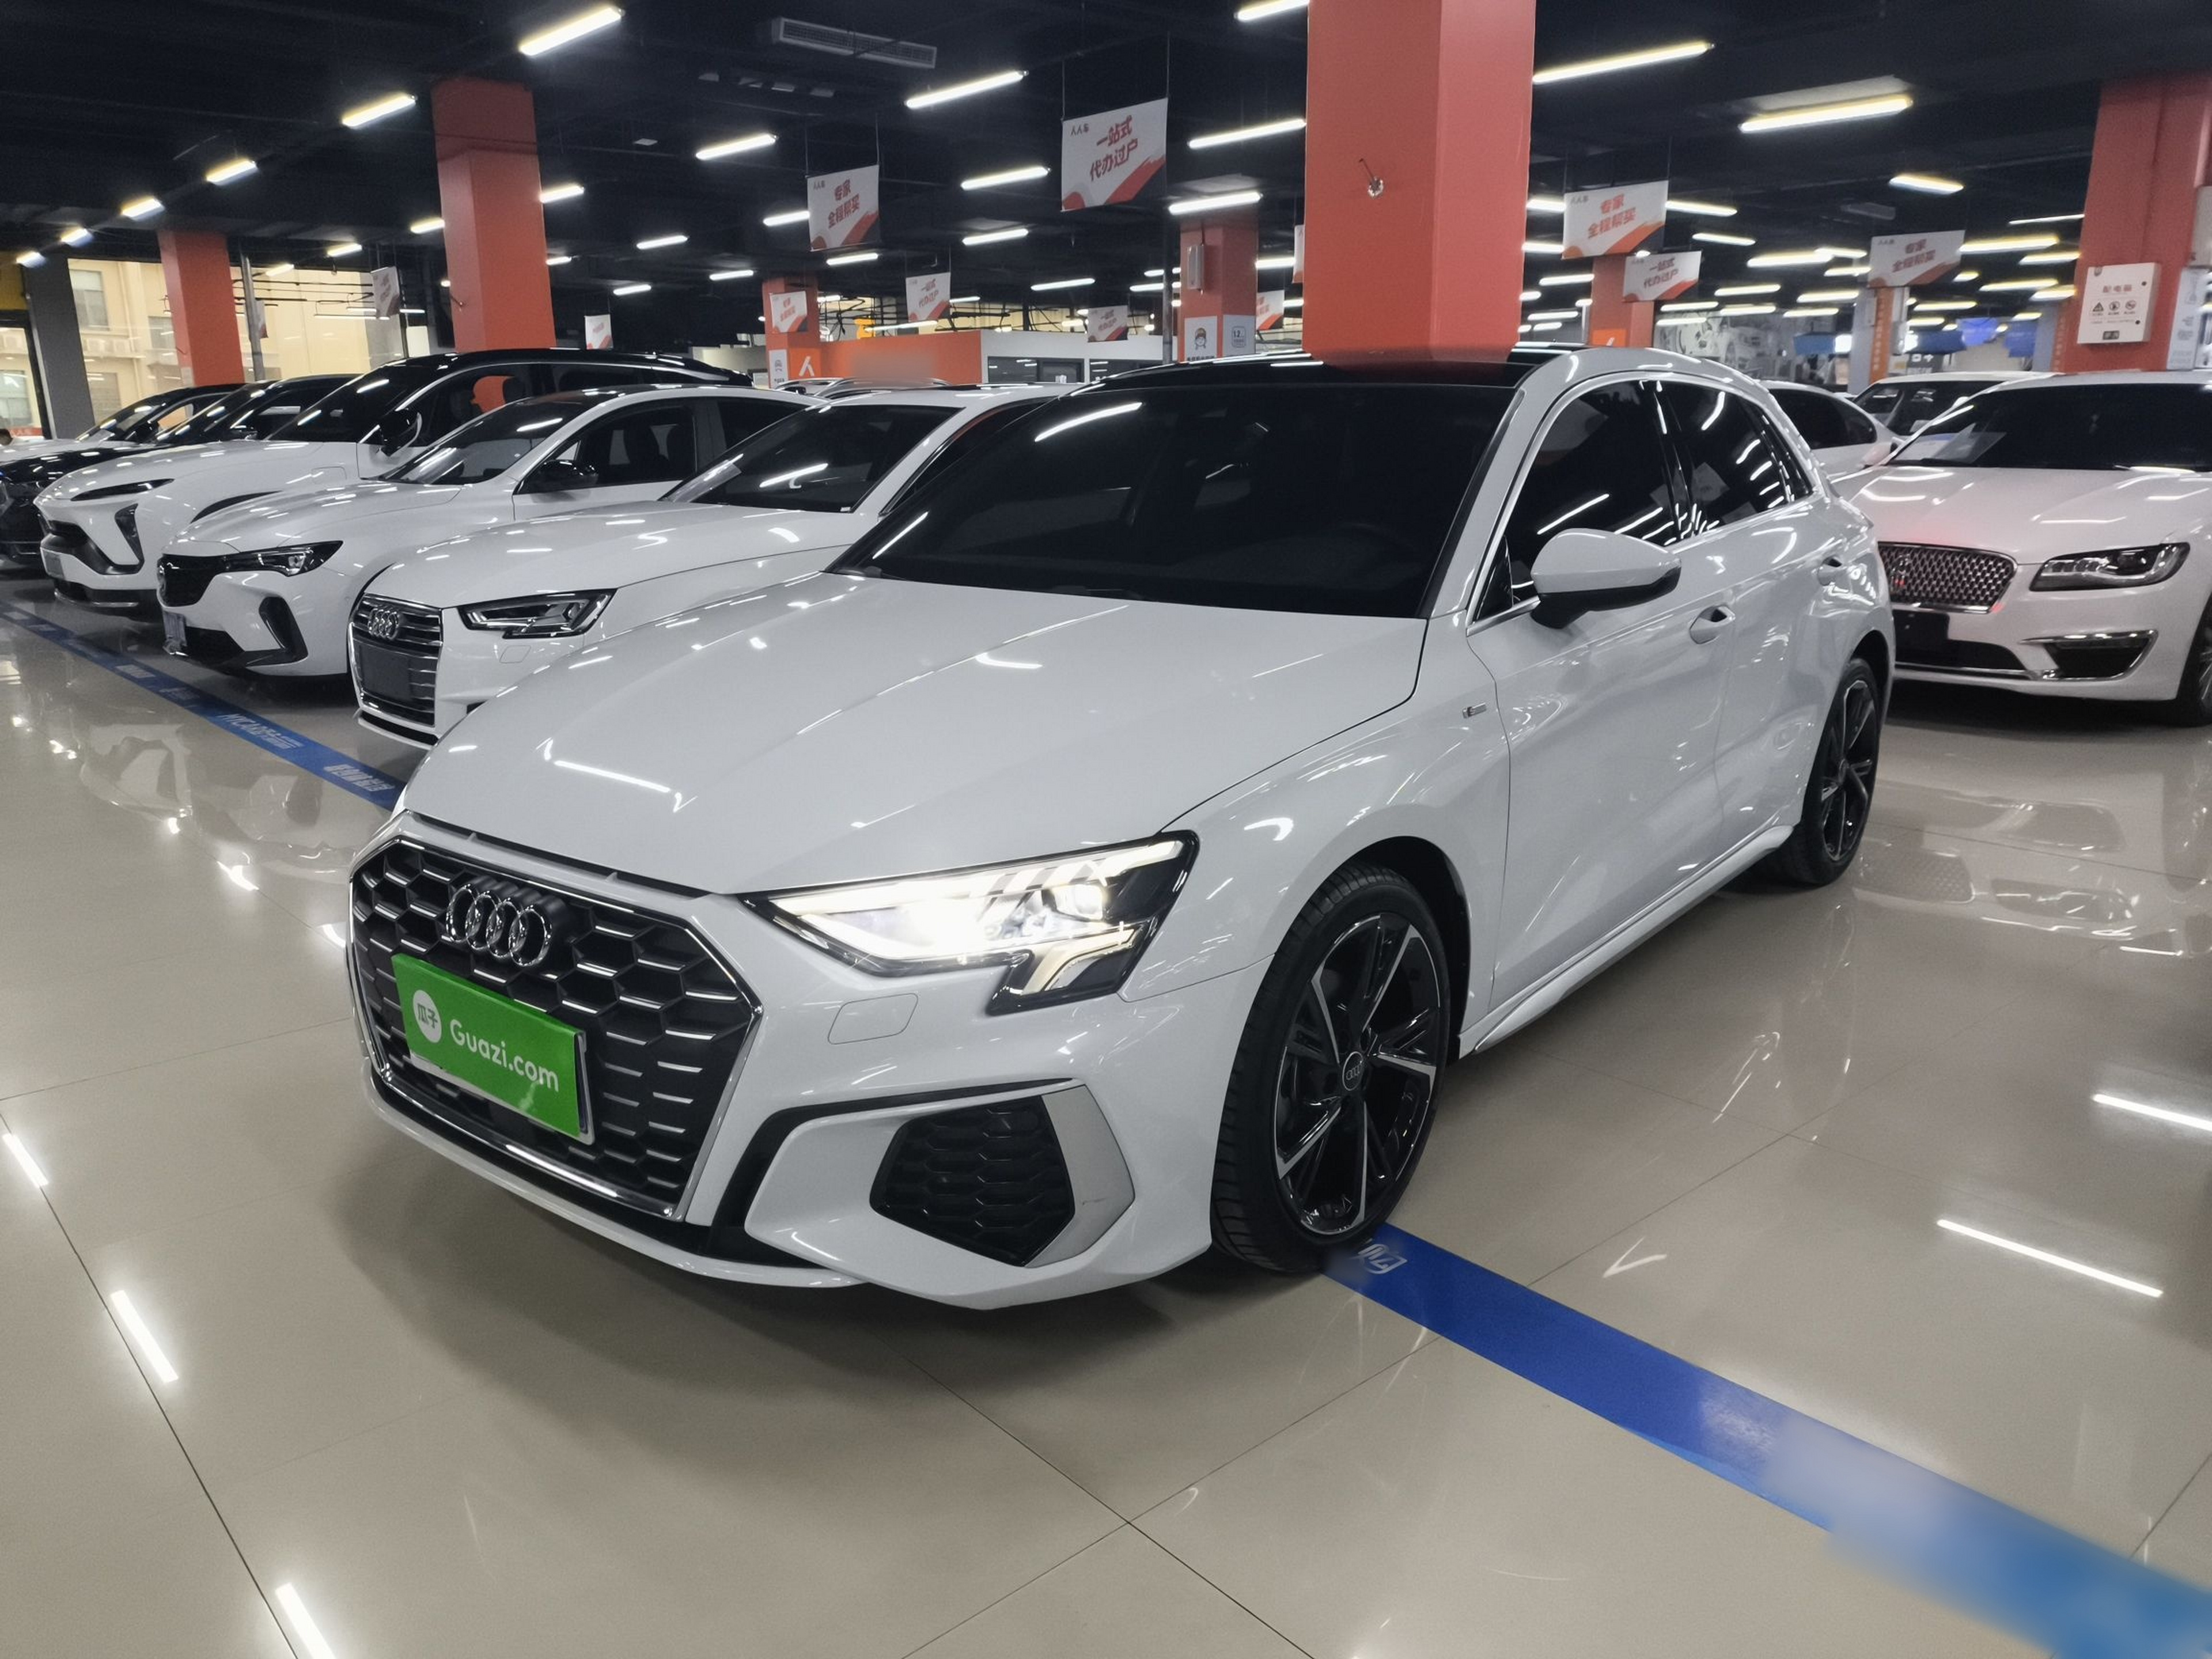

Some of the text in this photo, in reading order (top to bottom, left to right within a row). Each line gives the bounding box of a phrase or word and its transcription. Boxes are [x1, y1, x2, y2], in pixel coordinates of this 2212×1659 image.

[1097, 115, 1132, 146] 一站式
[1090, 138, 1138, 181] 代办过户
[834, 179, 851, 200] 专家
[1600, 194, 1624, 214] 专家
[828, 194, 859, 229] 全程帮买
[1588, 207, 1636, 238] 全程帮买
[417, 1003, 438, 1029] 瓜子
[450, 1019, 559, 1092] Guazi.com
